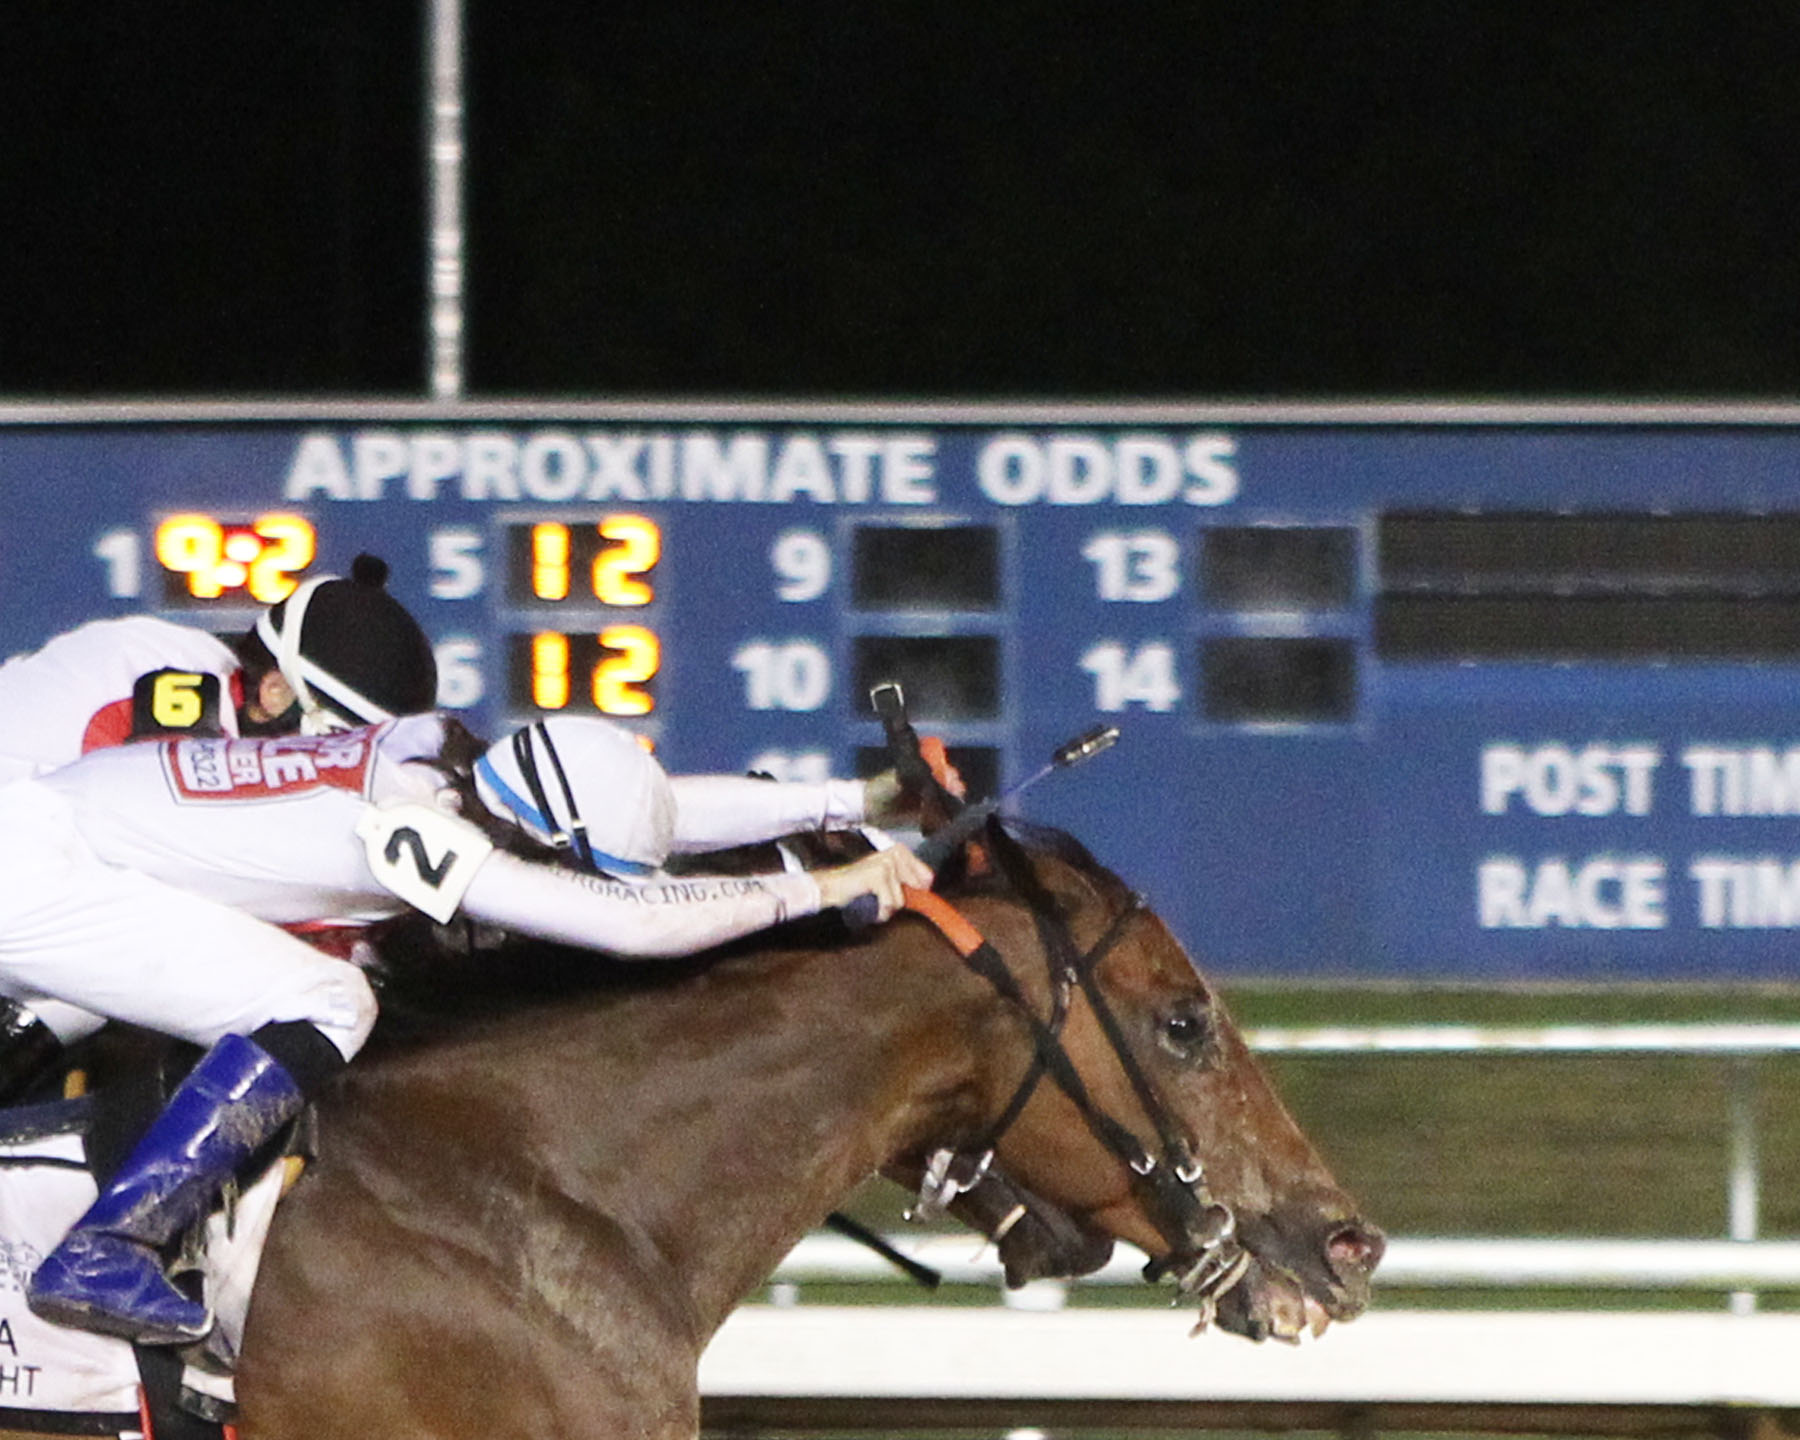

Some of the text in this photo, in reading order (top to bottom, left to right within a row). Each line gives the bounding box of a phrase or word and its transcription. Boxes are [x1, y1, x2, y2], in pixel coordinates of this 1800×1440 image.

[283, 434, 1240, 505] APPROXIMATE ODDS
[94, 528, 141, 598] 1
[430, 528, 485, 600] 5
[532, 513, 662, 606] 12
[772, 530, 832, 602] 9
[1083, 530, 1180, 602] 13
[153, 672, 203, 727] 6
[532, 624, 662, 716] 12
[732, 642, 831, 711] 10
[1083, 642, 1181, 711] 14
[1481, 744, 1661, 815] POST
[383, 815, 458, 890] 2
[1477, 857, 1668, 929] RACE
